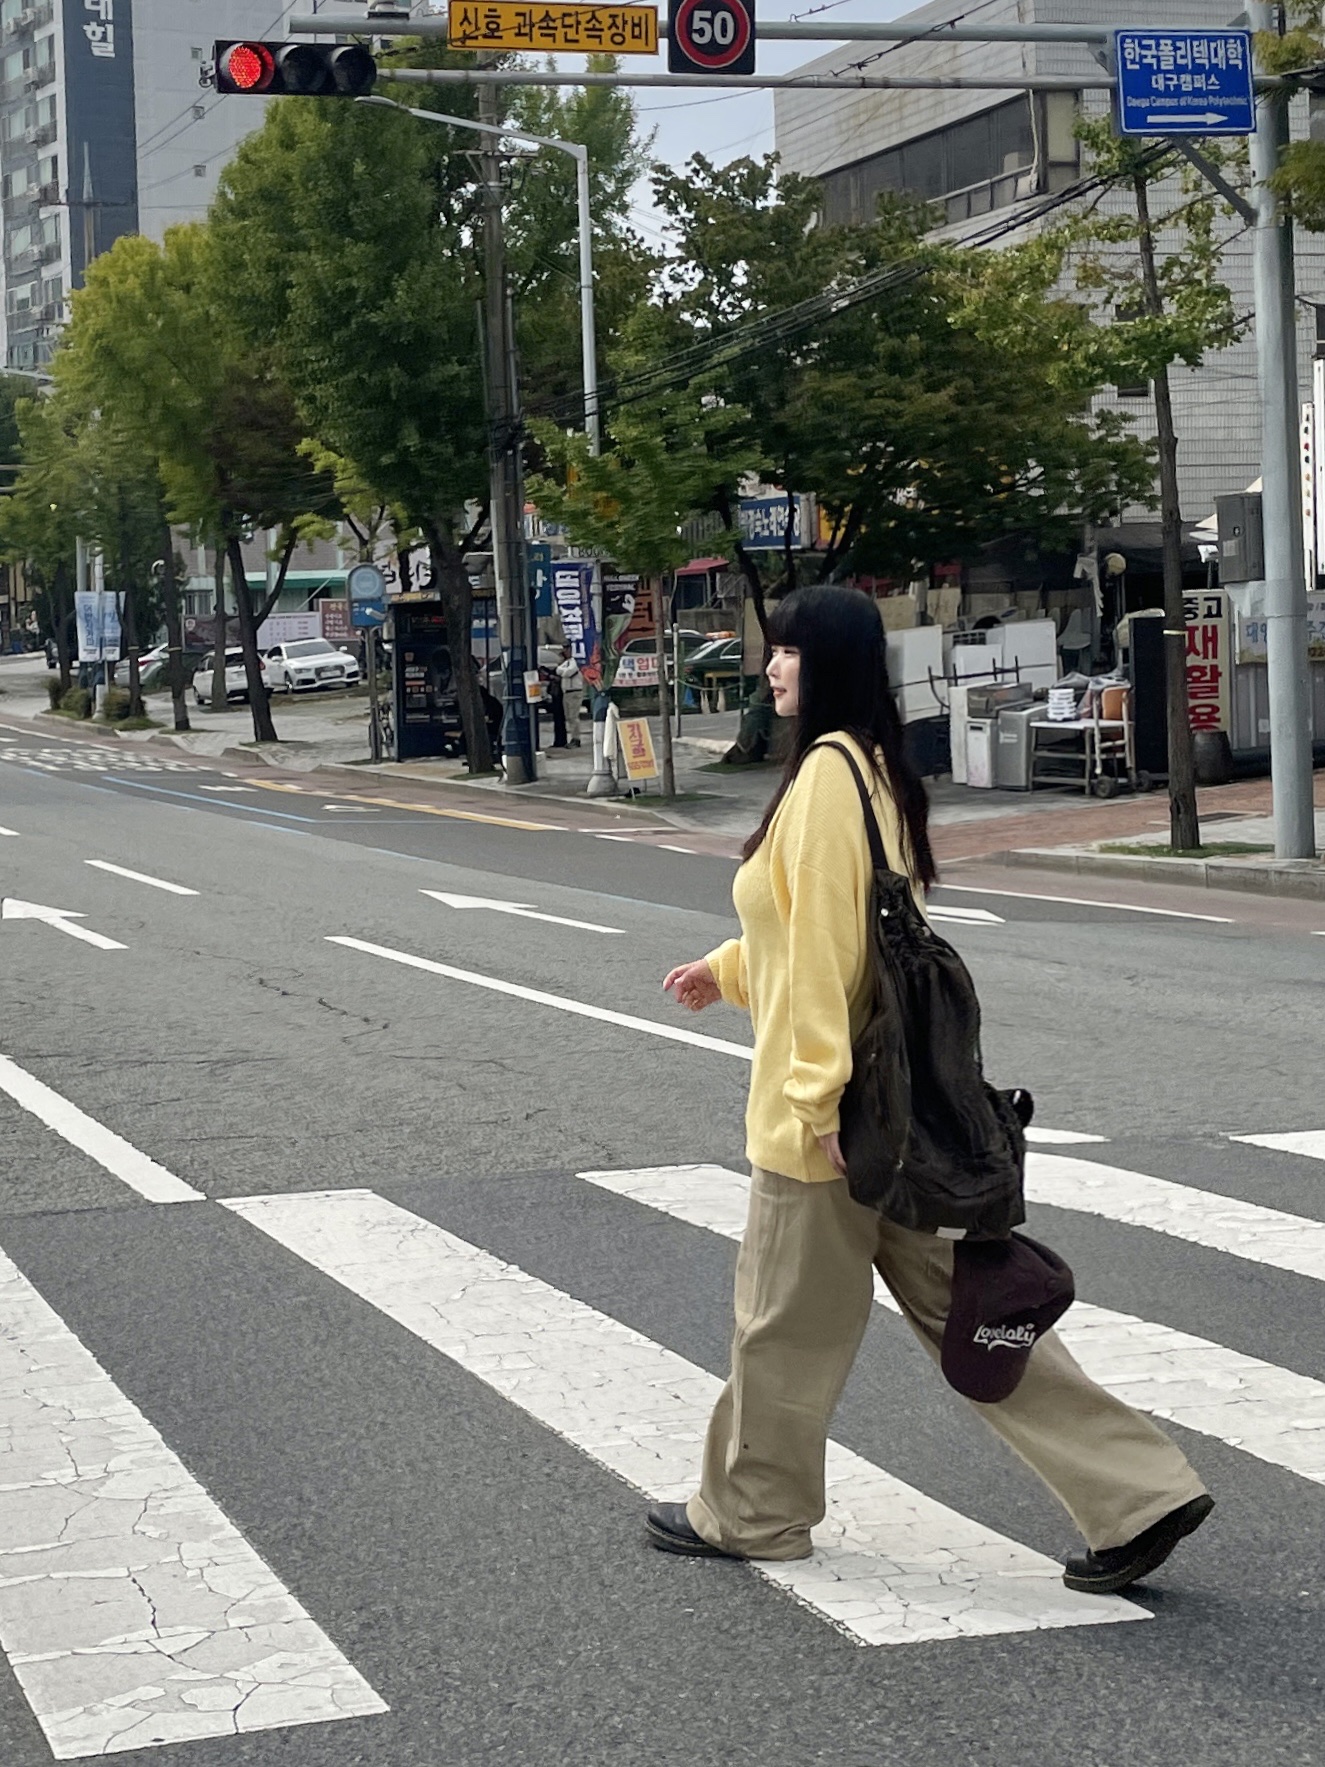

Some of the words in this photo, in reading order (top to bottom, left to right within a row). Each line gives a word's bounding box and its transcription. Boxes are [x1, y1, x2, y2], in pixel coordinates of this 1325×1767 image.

[459, 7, 503, 40] 신호
[513, 8, 649, 47] 과속단속장비
[692, 10, 735, 45] 50
[1123, 38, 1243, 71] 한국폴리텍대학
[1151, 73, 1221, 92] 대구캠퍼스
[1150, 96, 1179, 107] Campus
[1183, 596, 1223, 621] 중고
[1185, 624, 1223, 731] 재활용
